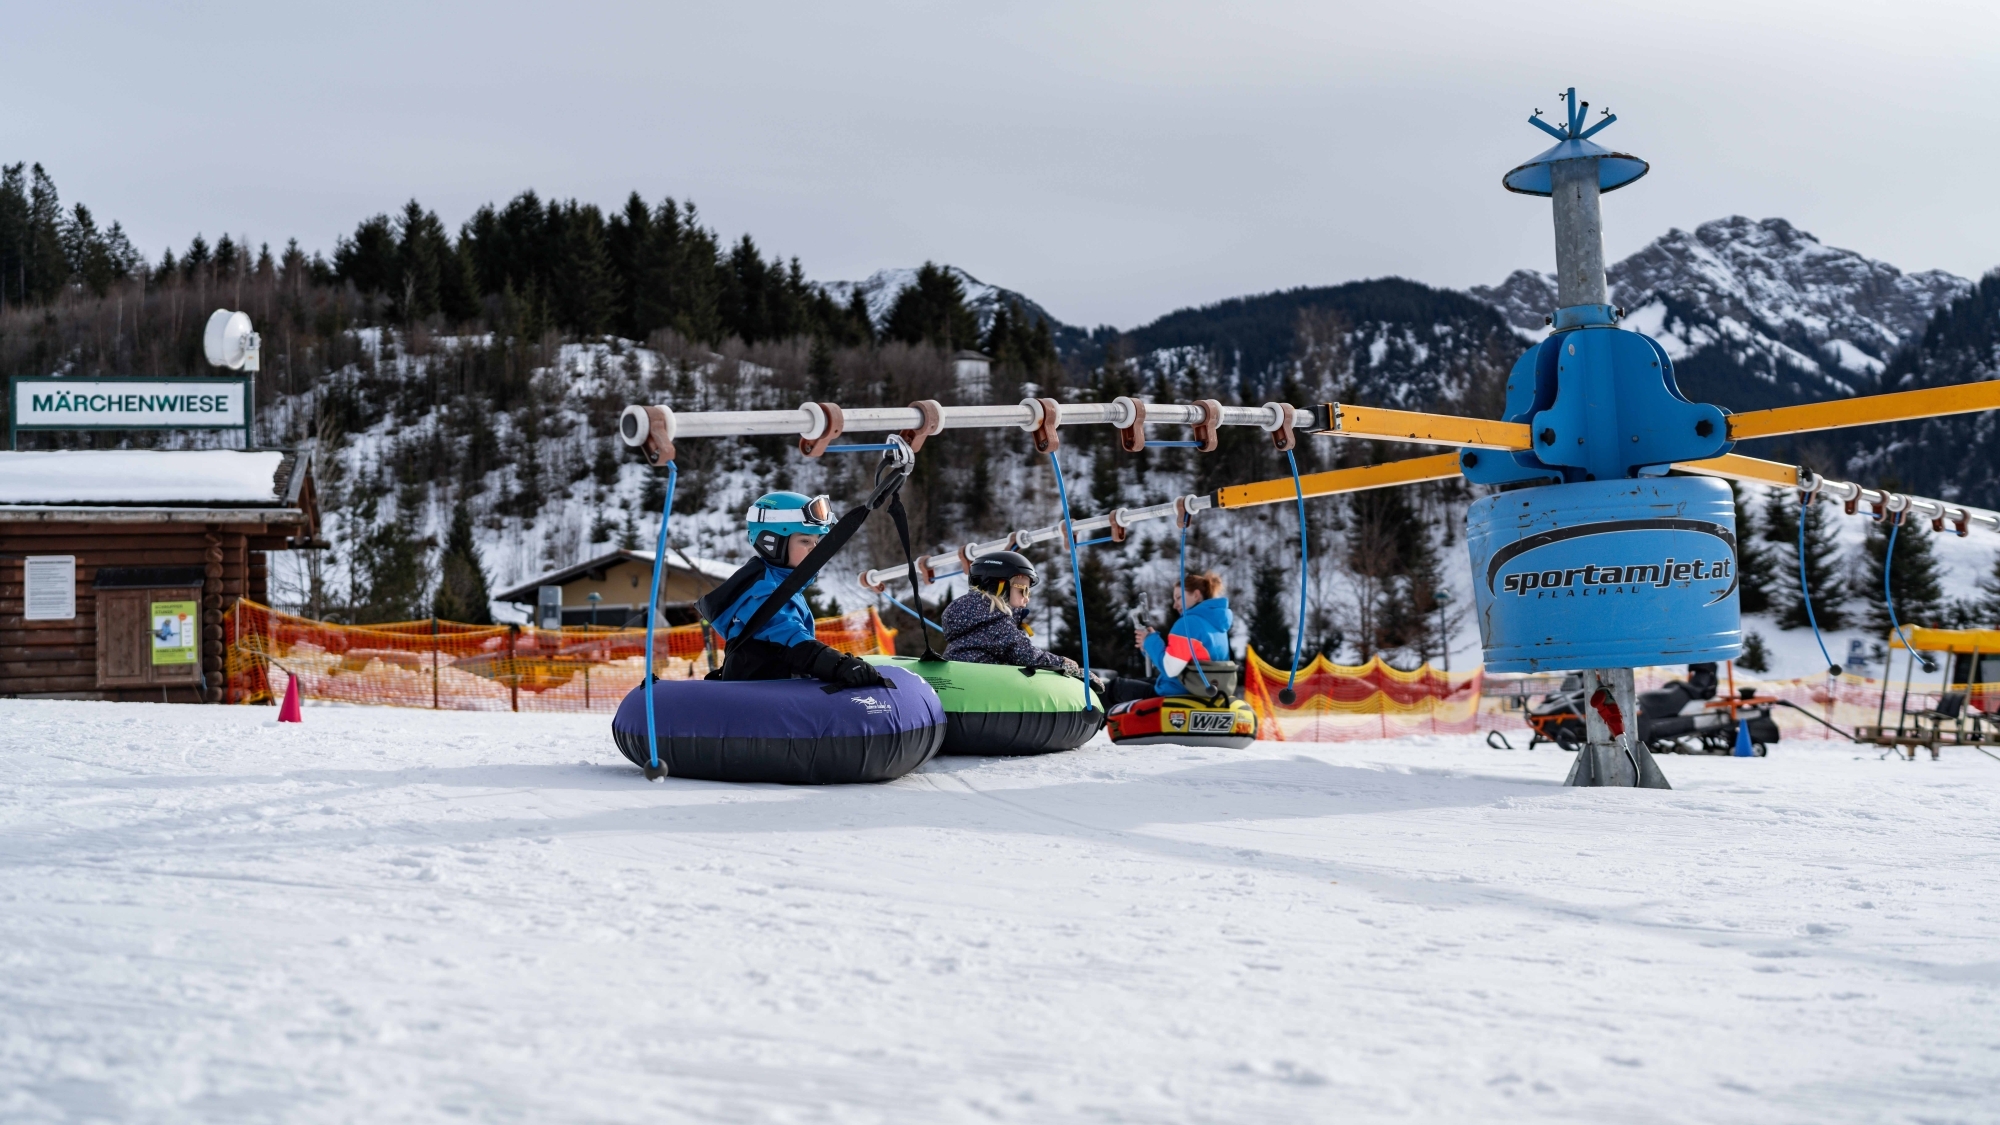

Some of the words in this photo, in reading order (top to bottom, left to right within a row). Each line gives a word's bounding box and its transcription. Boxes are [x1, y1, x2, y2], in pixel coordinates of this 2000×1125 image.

[32, 390, 229, 413] MÄRCHENWIESE
[1504, 557, 1731, 597] sportamjet.at
[1537, 586, 1641, 600] FLACHAU
[1192, 714, 1233, 730] WIZ
